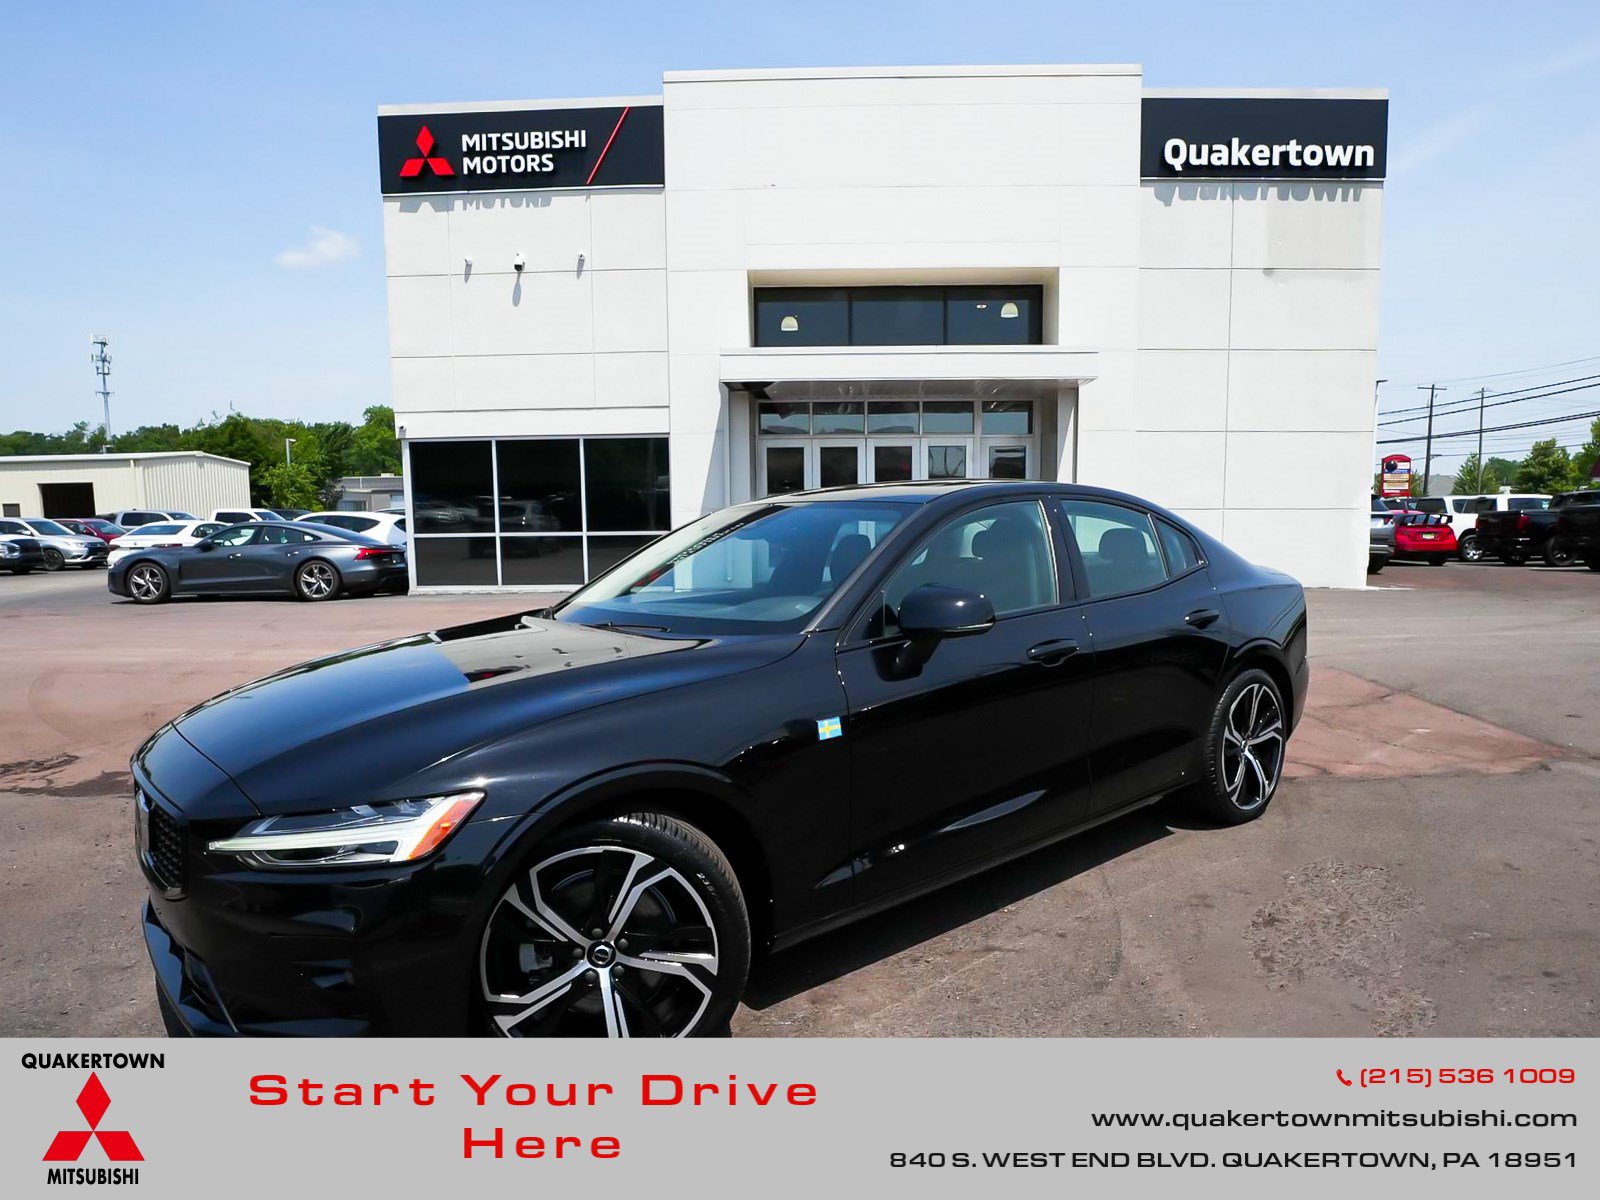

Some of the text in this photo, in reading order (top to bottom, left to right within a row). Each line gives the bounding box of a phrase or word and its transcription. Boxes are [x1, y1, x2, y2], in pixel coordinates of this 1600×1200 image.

[461, 129, 587, 152] MITSUBISHI
[462, 153, 554, 175] MOTORS
[1164, 137, 1375, 171] Quakertown
